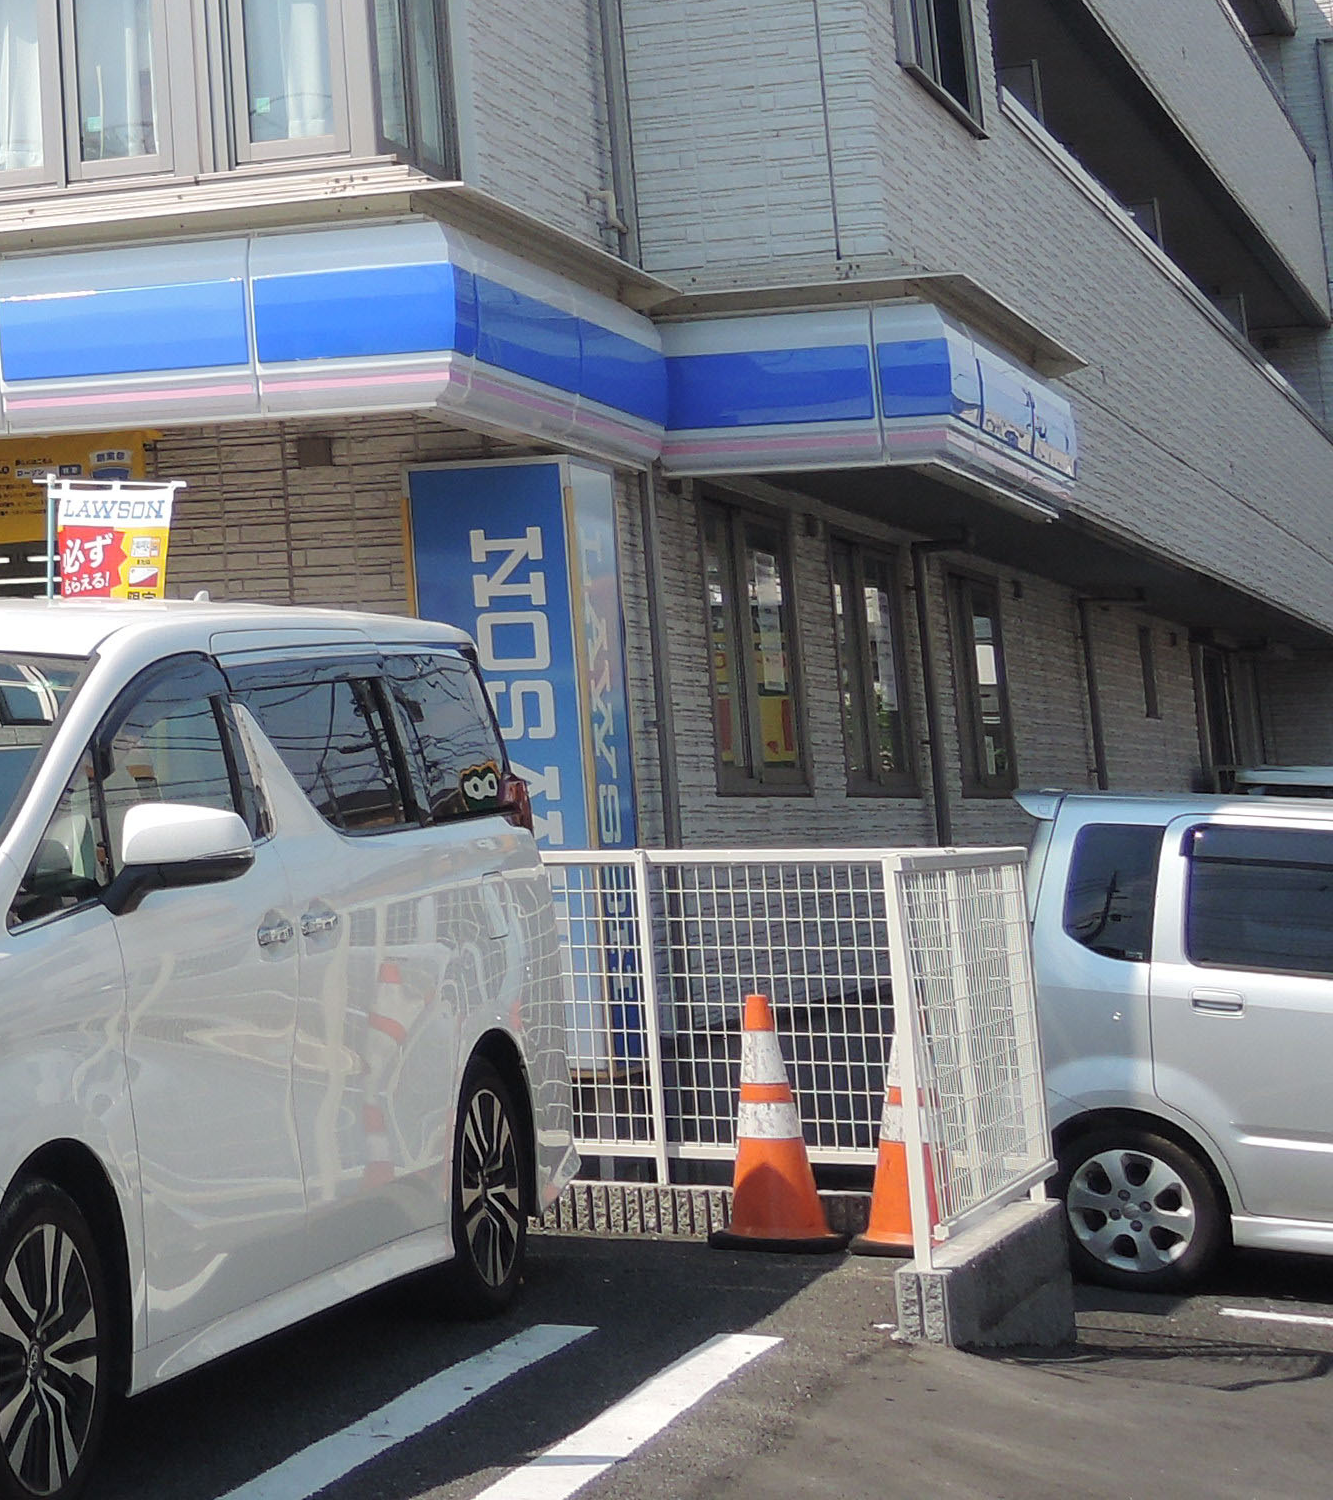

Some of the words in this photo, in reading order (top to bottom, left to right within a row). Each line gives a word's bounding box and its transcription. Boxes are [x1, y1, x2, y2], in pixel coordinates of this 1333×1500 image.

[17, 468, 45, 477] ローソン
[63, 500, 165, 519] LAWSON
[62, 531, 114, 574] 必ず
